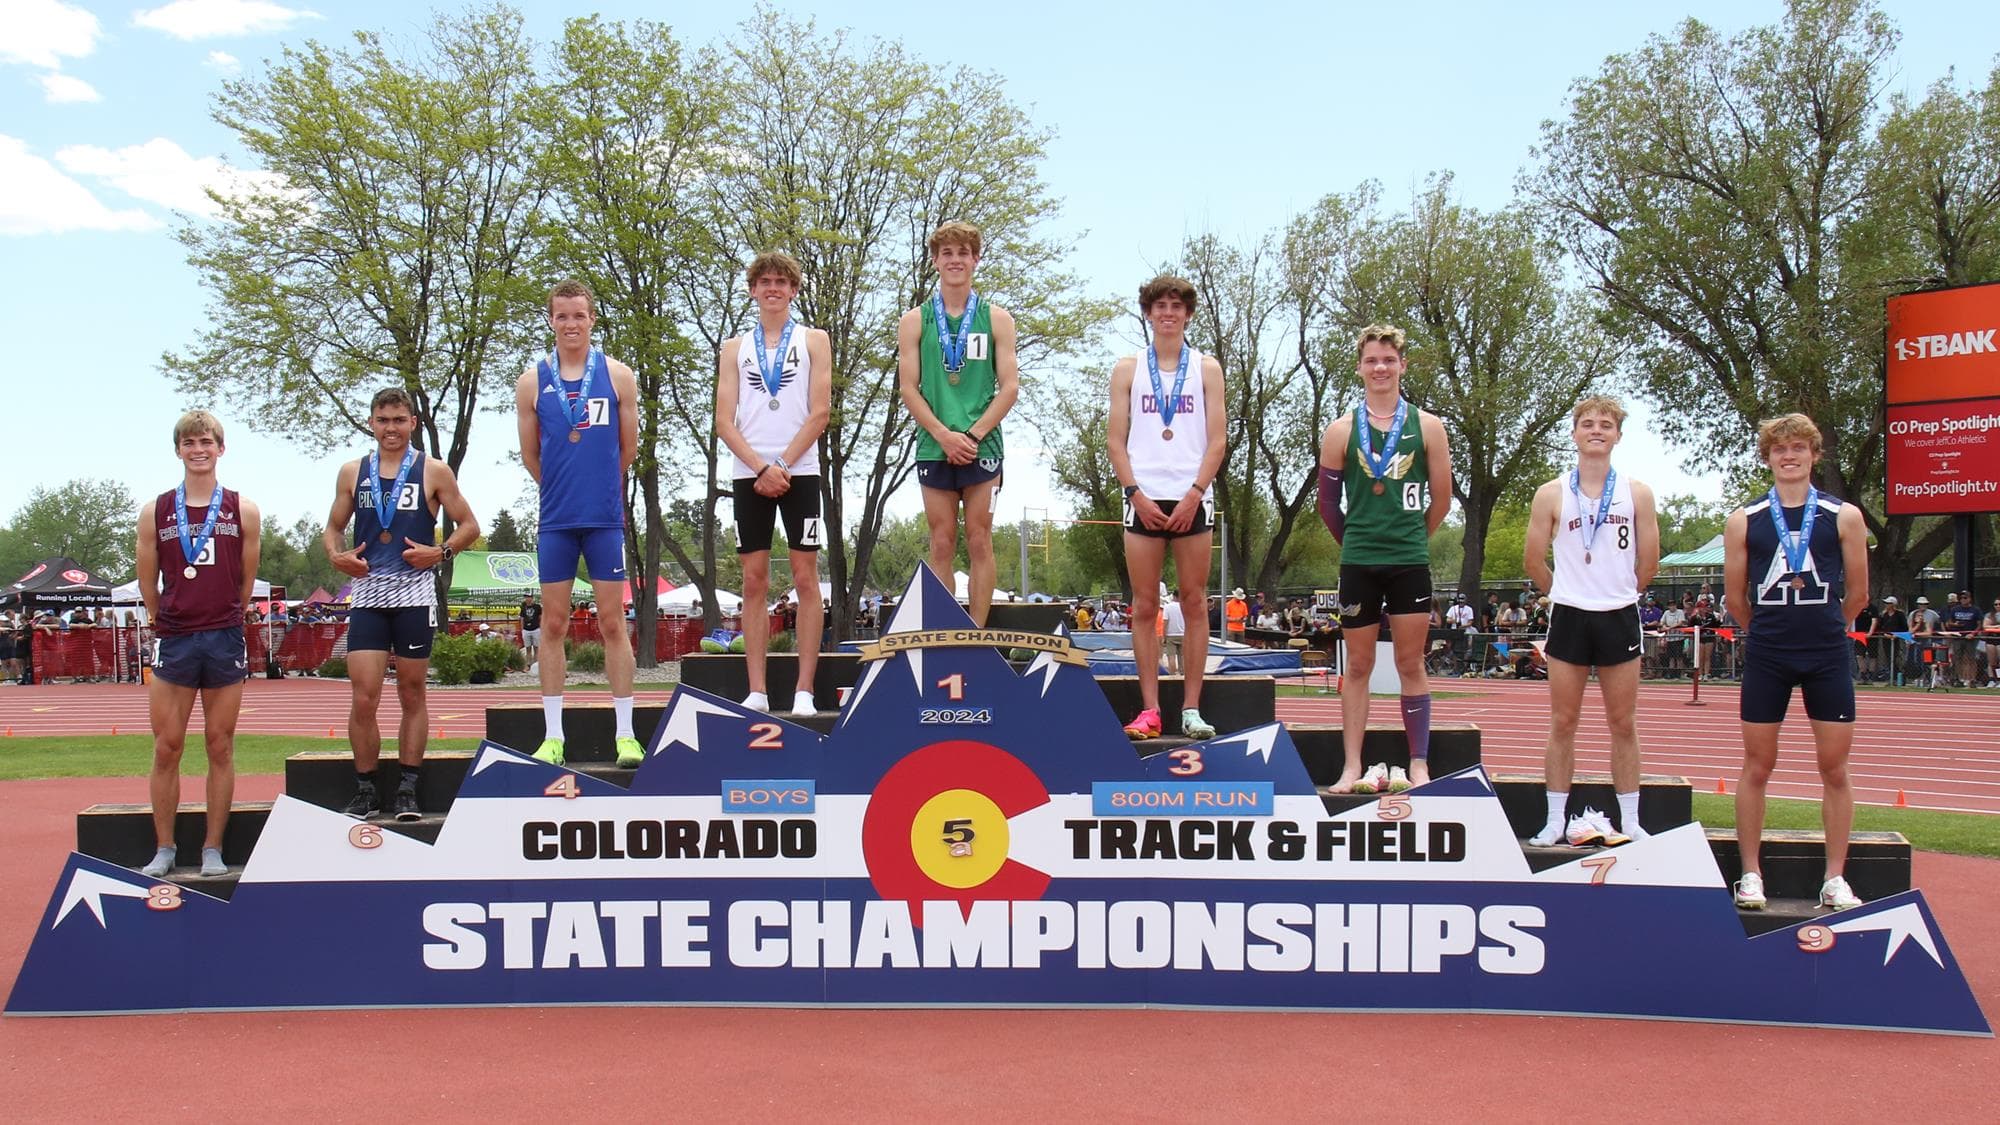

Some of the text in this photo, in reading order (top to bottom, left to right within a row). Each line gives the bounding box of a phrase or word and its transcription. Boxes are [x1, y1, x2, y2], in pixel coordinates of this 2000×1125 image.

[787, 346, 800, 367] 4
[973, 335, 981, 357] 1
[593, 401, 604, 423] 7
[1142, 395, 1194, 413] COINS
[1889, 414, 2000, 435] CO Prep Spotlight
[1904, 439, 1915, 447] We
[1917, 439, 1934, 447] cover
[1958, 435, 1986, 444] Athletics
[359, 491, 376, 508] PIN
[402, 486, 414, 508] 3
[1406, 484, 1416, 508] 6
[1895, 480, 1997, 497] PrepSpotlight.tv
[159, 522, 239, 541] CHEKE TRAIL
[807, 520, 818, 543] 4
[1569, 514, 1629, 531] RES ESUIT
[1618, 525, 1629, 549] 8
[36, 594, 67, 602] Running
[69, 594, 95, 602] Locally
[885, 631, 1063, 649] STATE CHAMPION
[937, 673, 963, 700] 1
[920, 709, 991, 723] 2024
[748, 722, 783, 749] 2
[1168, 749, 1204, 776] 3
[544, 774, 581, 799] 4
[729, 789, 809, 804] BOYS
[1111, 791, 1257, 807] 800M RUN
[1376, 795, 1413, 820] 5
[348, 823, 383, 849] 6
[522, 819, 817, 860] COLORADO
[942, 820, 975, 844] 5
[1064, 819, 1466, 862] TRACK & FIELD
[1580, 856, 1617, 885] 7
[147, 884, 183, 911] 8
[422, 900, 1546, 975] STATE CHAMPIONSHIPS
[1796, 924, 1836, 953] 9
